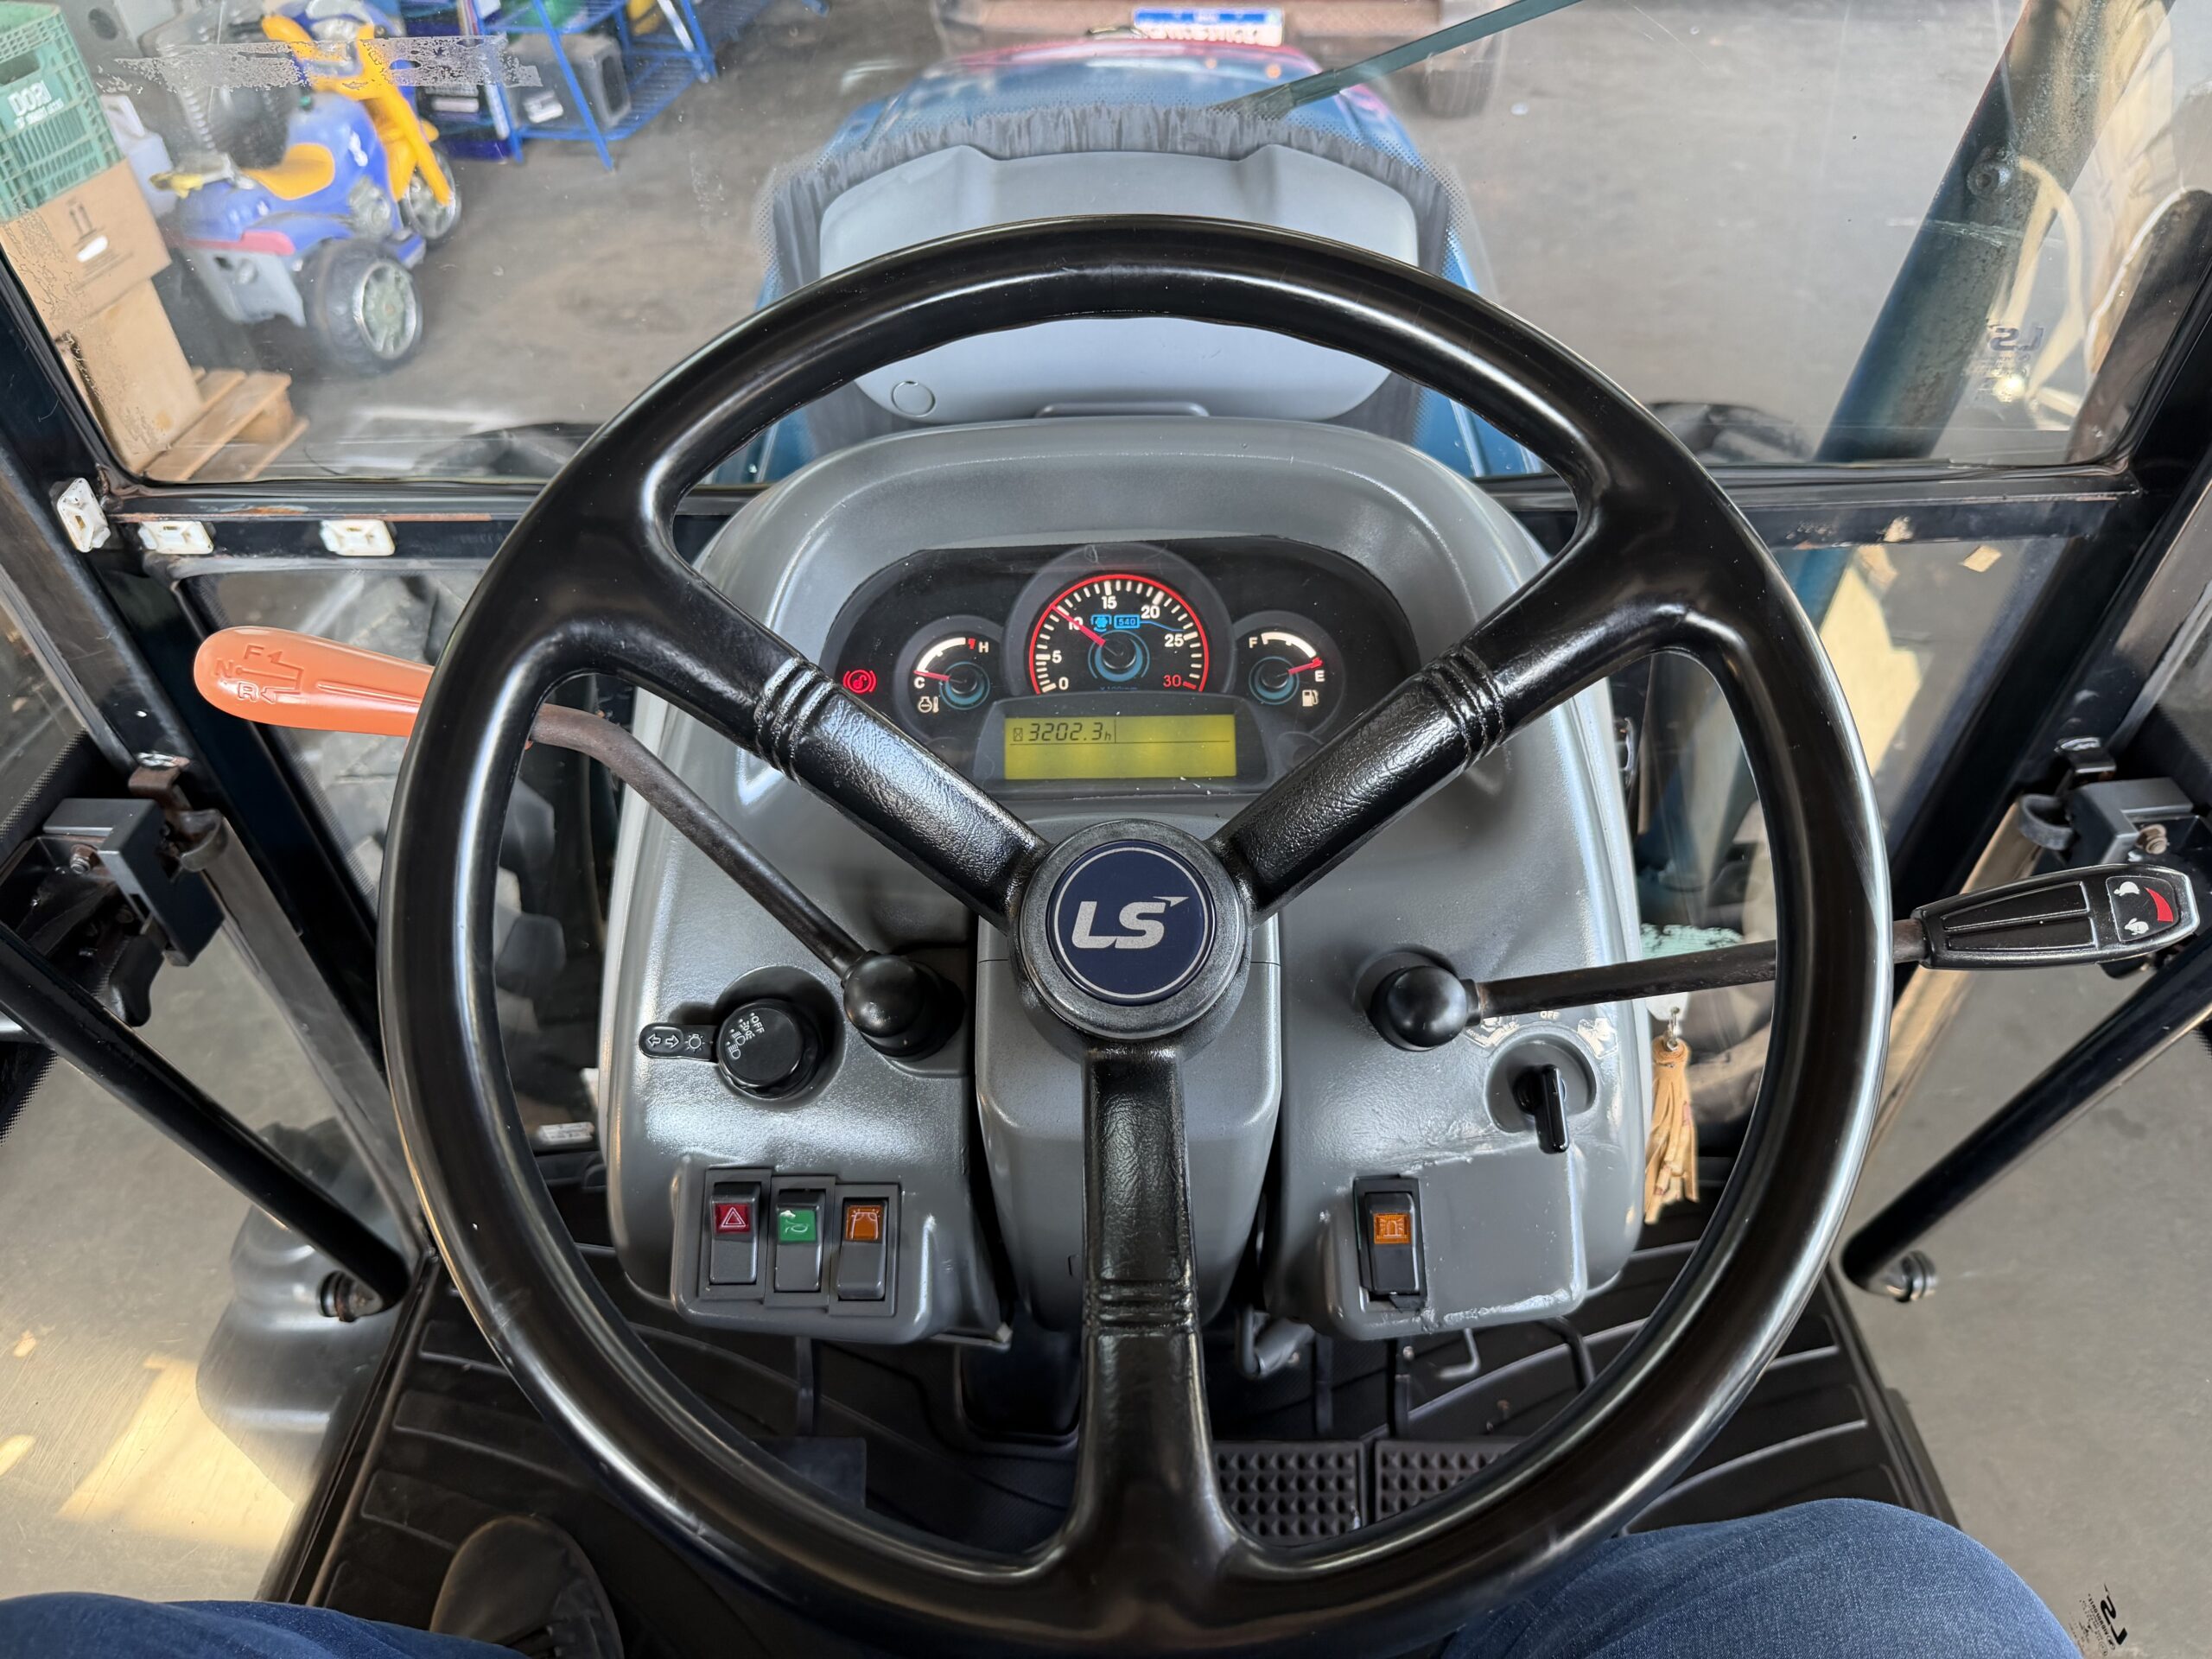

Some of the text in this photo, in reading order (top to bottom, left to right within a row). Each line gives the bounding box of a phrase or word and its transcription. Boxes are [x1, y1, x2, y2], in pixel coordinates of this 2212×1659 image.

[1102, 596, 1117, 609] 15
[1141, 605, 1160, 619] 20
[1068, 617, 1084, 631] 10
[1118, 618, 1136, 626] 540
[978, 641, 989, 653] H
[1164, 633, 1185, 647] 25
[1249, 637, 1258, 649] F
[244, 644, 264, 659] F
[1052, 650, 1062, 664] 5
[214, 658, 235, 678] N
[914, 677, 925, 689] C
[1163, 675, 1182, 688] 30
[1314, 670, 1325, 682] E
[1058, 677, 1069, 690] 0
[237, 681, 259, 702] R
[1071, 899, 1166, 949] LS
[751, 1015, 765, 1033] OFF
